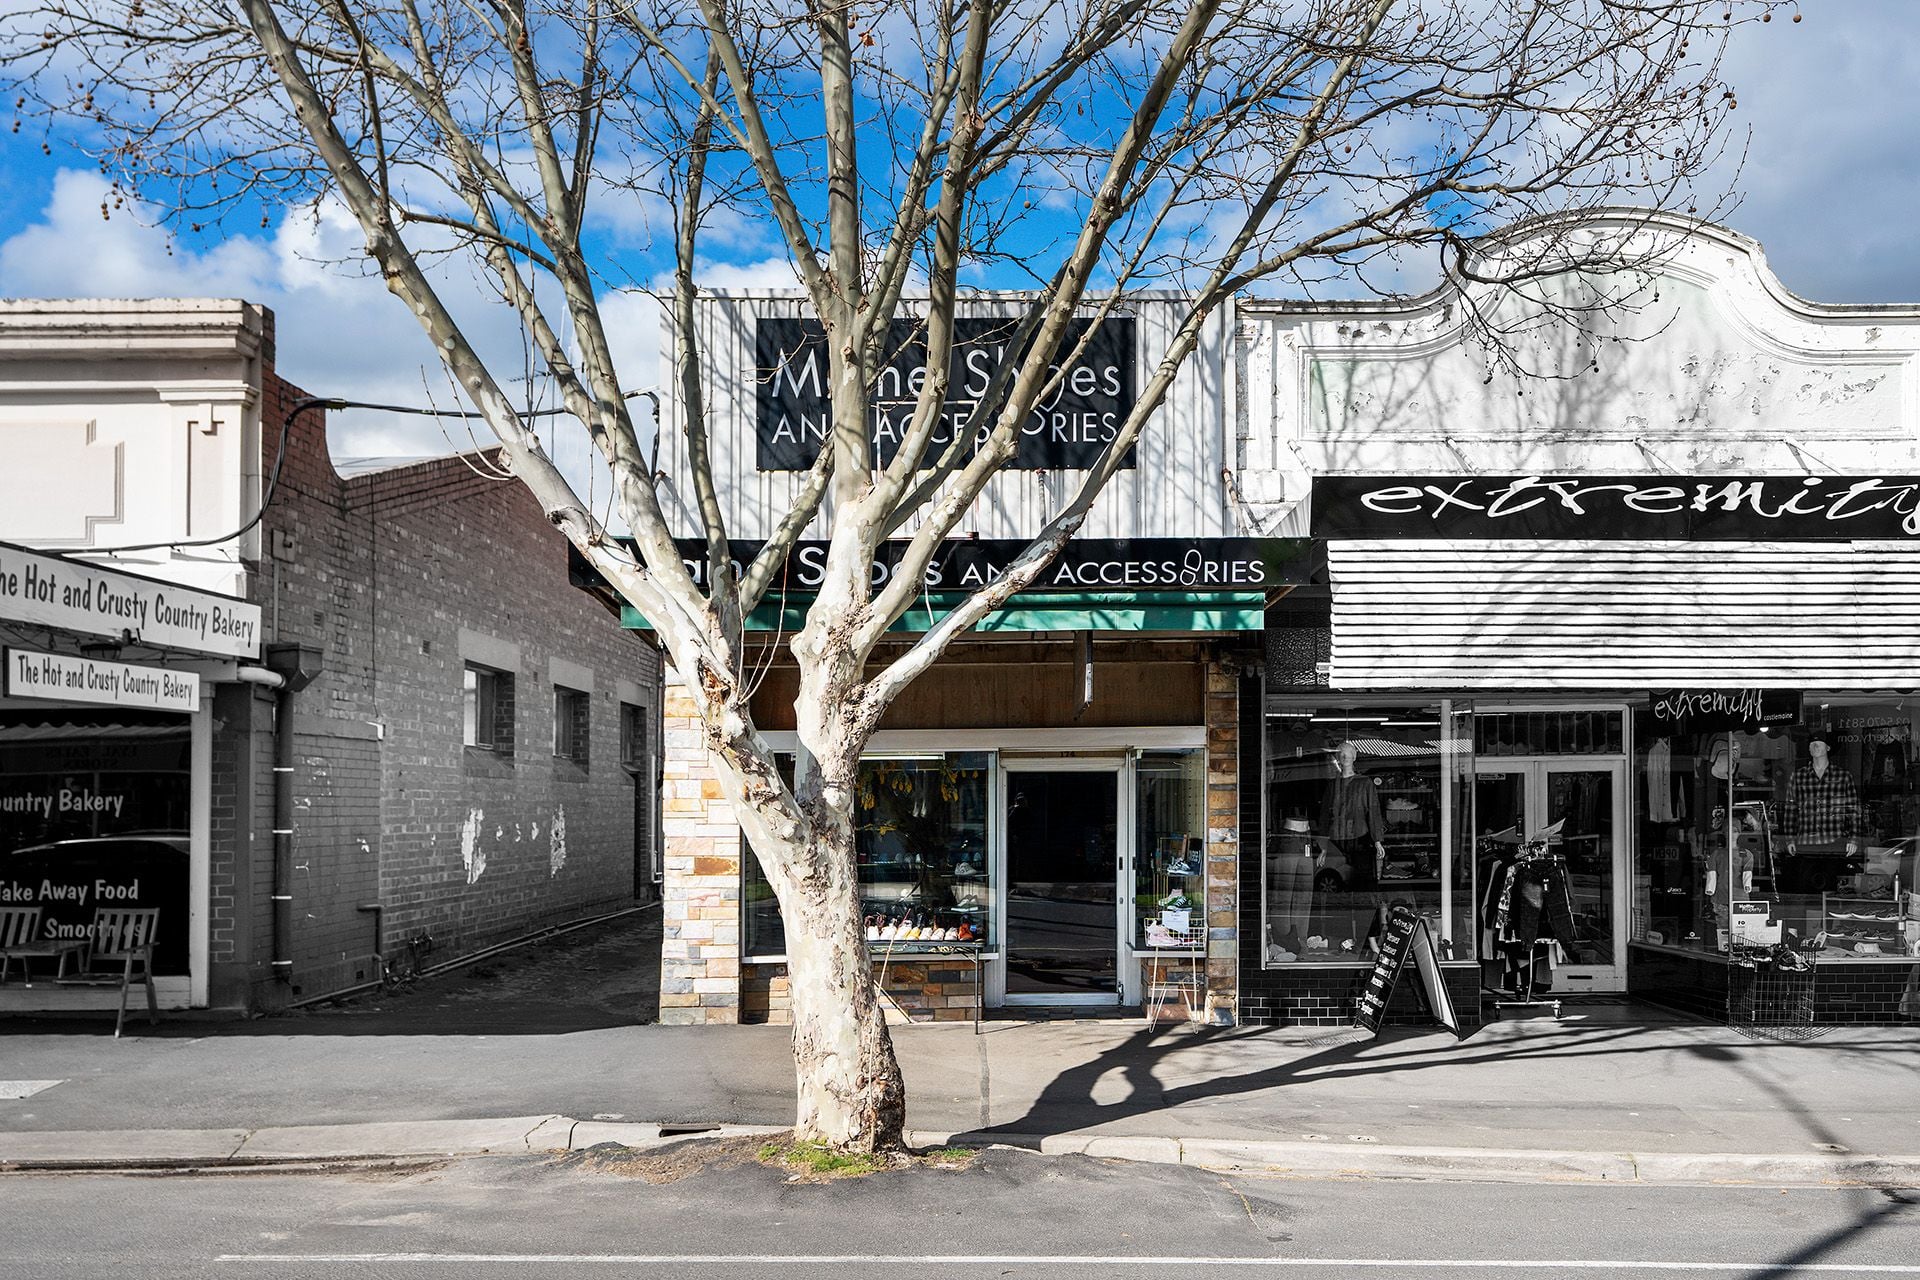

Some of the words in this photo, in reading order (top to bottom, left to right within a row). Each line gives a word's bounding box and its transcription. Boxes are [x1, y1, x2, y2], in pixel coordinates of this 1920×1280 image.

[771, 347, 930, 399] Mne
[771, 413, 828, 444] AN
[1361, 476, 1920, 535] extremity
[796, 546, 943, 586] Sos
[960, 562, 1004, 585] AN
[25, 563, 56, 604] Hot
[63, 577, 91, 612] and
[97, 581, 147, 630] Crusty
[155, 593, 208, 640] Country
[212, 606, 254, 648] Bakery
[18, 655, 39, 684] The
[42, 657, 63, 688] Hot
[66, 666, 84, 690] and
[87, 667, 120, 699] Crusty
[123, 670, 159, 703] Country
[163, 673, 193, 706] Bakery
[1763, 712, 1793, 721] castlemaine
[0, 791, 53, 819] untry
[58, 788, 124, 818] Bakery
[38, 878, 88, 906] Away
[95, 878, 139, 901] Food
